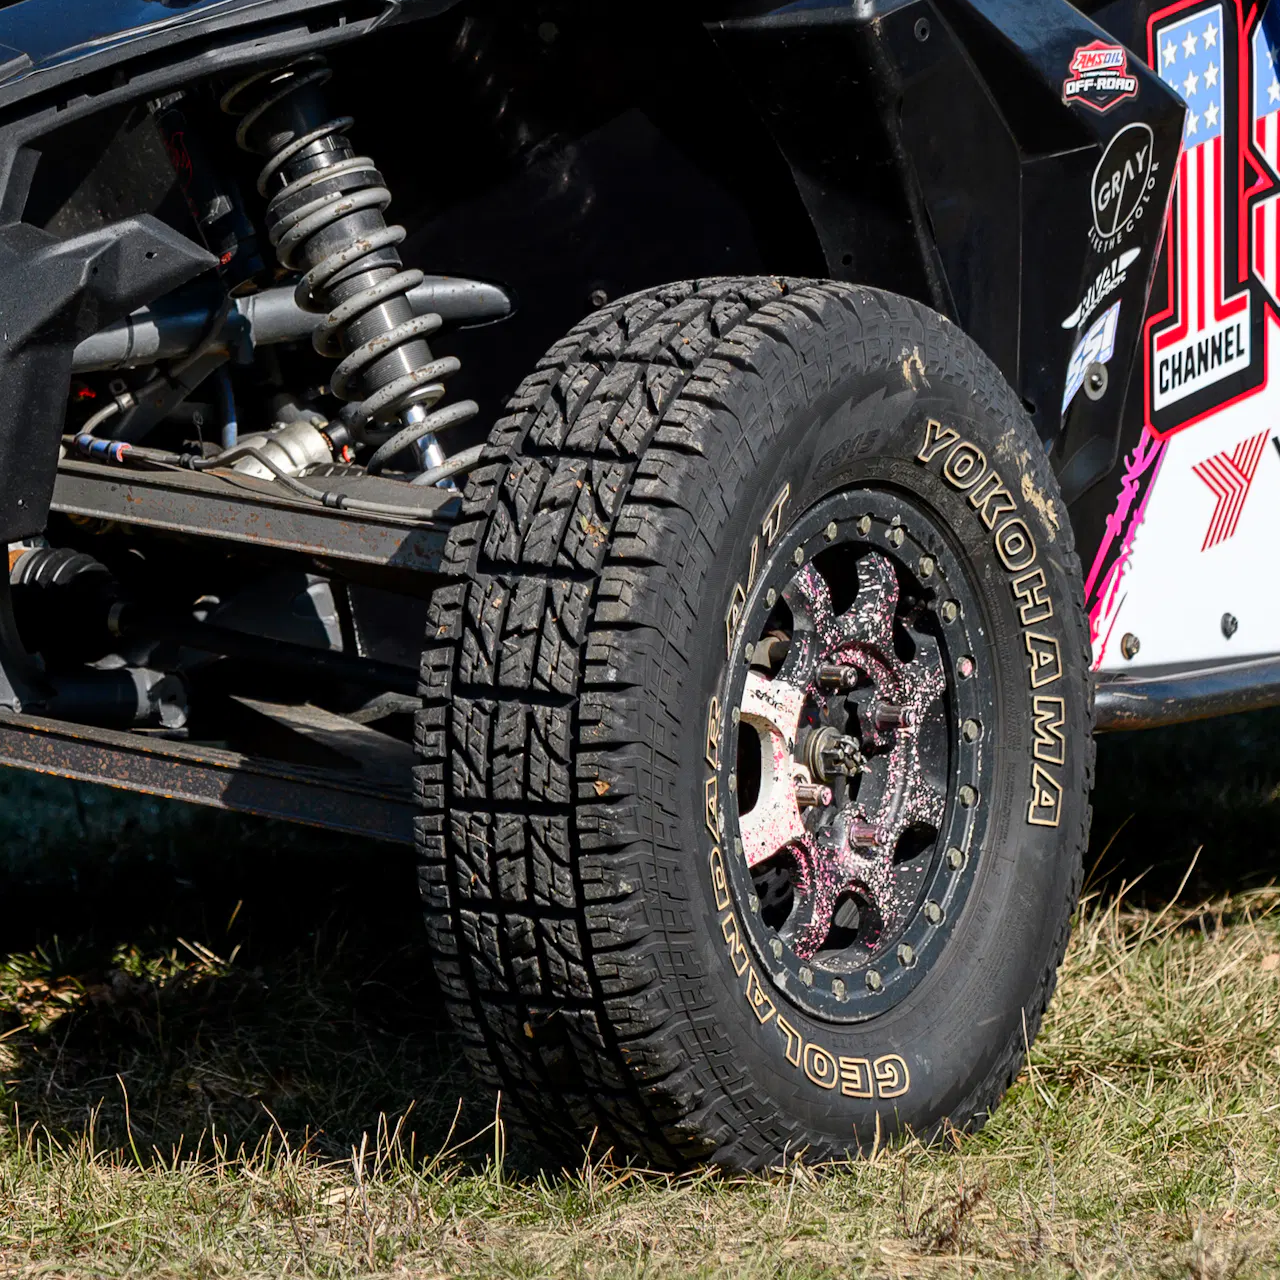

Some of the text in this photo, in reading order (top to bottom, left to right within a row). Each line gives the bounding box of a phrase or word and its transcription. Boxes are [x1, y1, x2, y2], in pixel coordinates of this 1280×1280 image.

[1078, 51, 1124, 70] AMSOIL
[1097, 144, 1149, 212] GRAY
[1125, 161, 1160, 233] COLOR
[1158, 323, 1246, 395] CHANNEL
[916, 418, 1065, 827] YOKOHAMA
[705, 694, 910, 1100] GEOLANDAR
